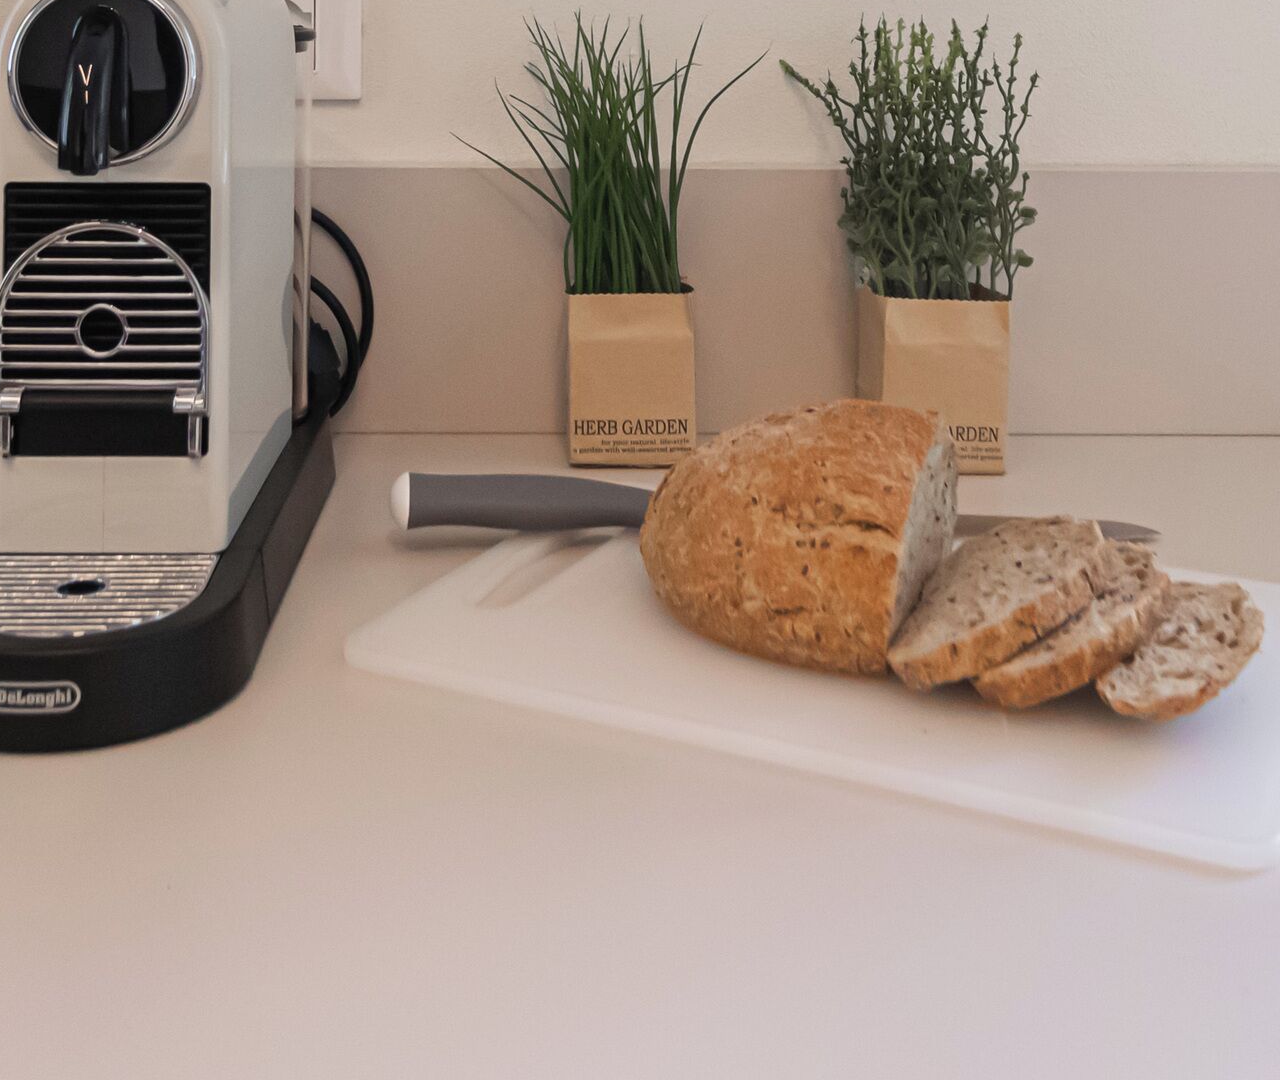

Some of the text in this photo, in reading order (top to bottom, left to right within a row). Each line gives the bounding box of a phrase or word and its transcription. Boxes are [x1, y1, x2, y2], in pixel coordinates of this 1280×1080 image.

[574, 418, 688, 435] HERB GARDEN
[948, 425, 999, 442] RDEN
